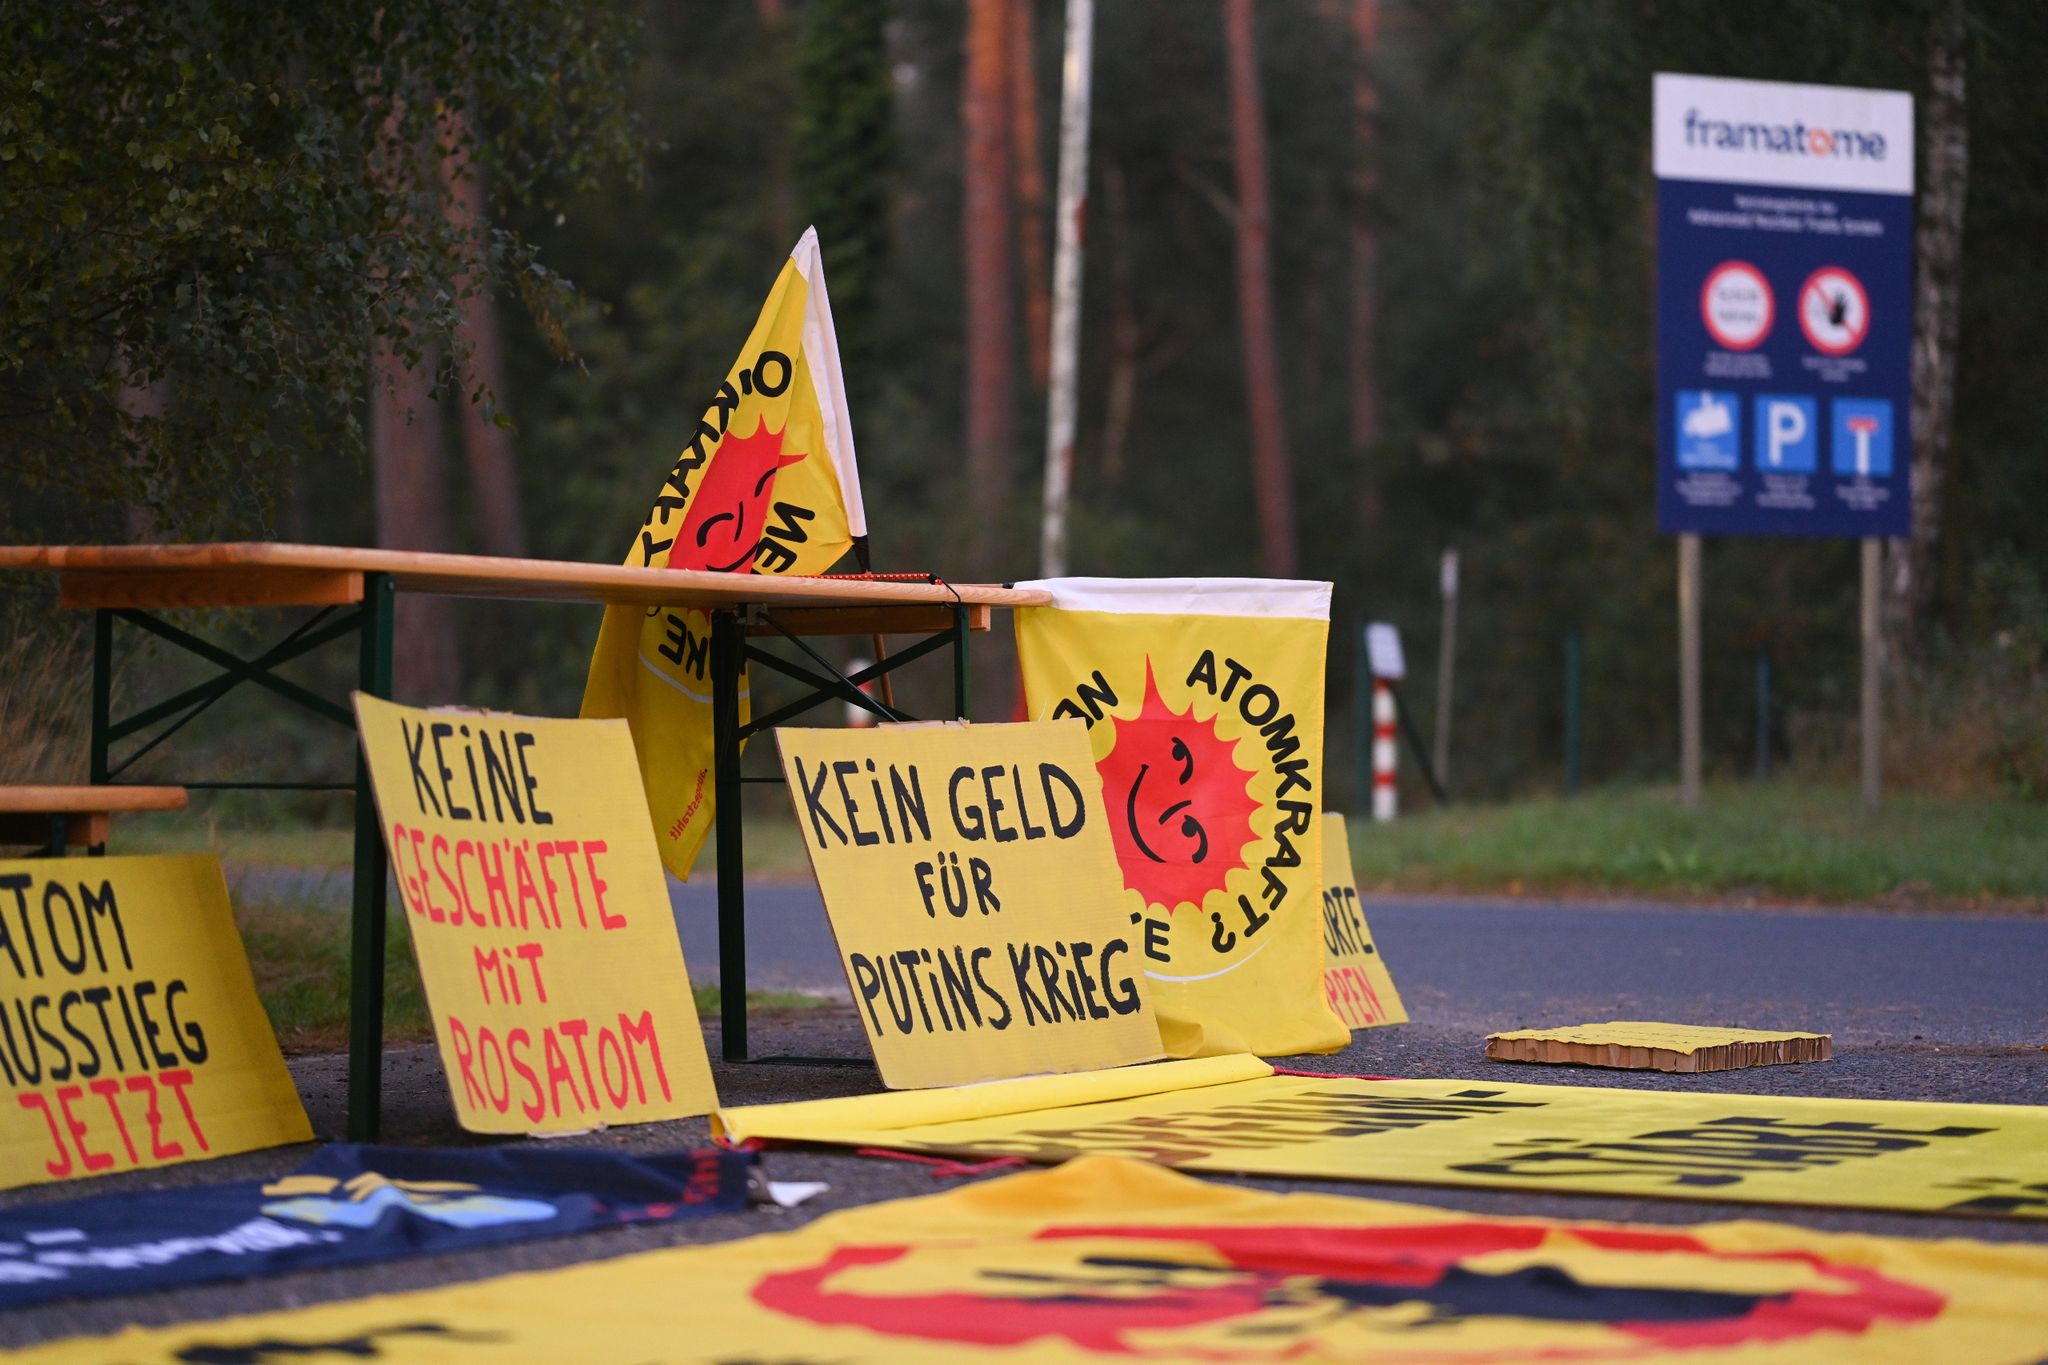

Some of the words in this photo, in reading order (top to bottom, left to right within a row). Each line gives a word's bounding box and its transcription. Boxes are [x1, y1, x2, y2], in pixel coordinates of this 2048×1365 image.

[1685, 107, 1888, 162] framatome
[948, 762, 1086, 843] GELD
[1186, 649, 1313, 953] ATOMKRAFT?
[394, 822, 627, 931] GESCHÄFTE
[914, 851, 1001, 919] FÜR
[0, 979, 209, 1087] USSTIEG
[448, 1010, 673, 1124] ROSATOM
[16, 1067, 210, 1178] JETZT
